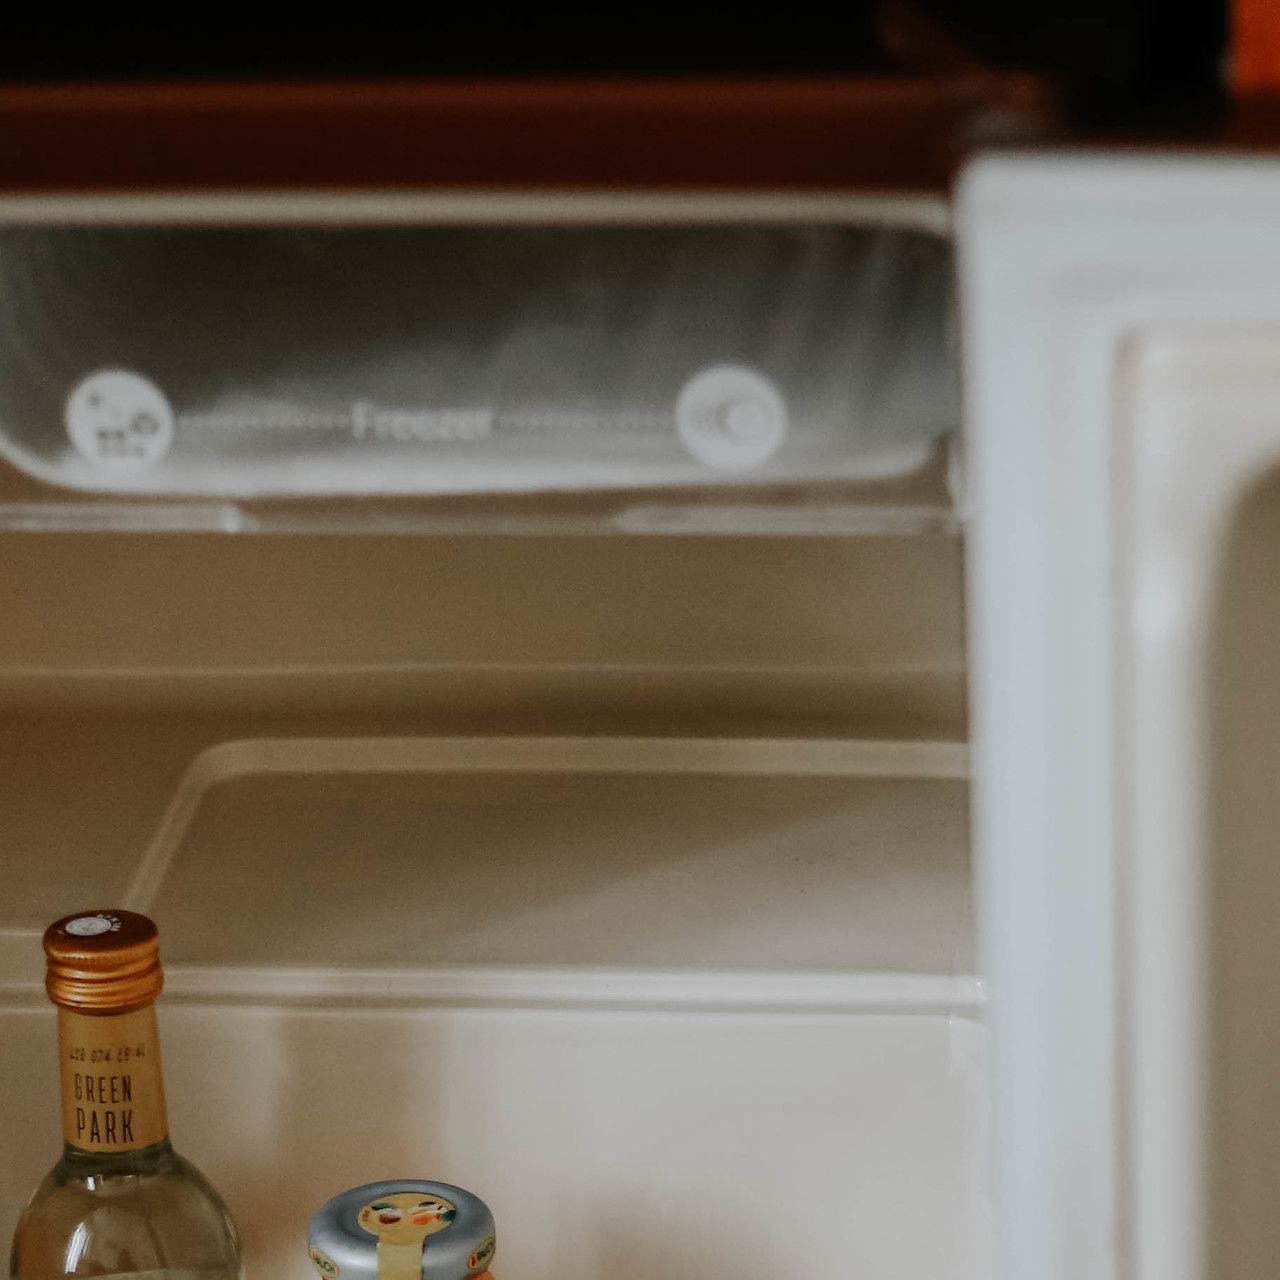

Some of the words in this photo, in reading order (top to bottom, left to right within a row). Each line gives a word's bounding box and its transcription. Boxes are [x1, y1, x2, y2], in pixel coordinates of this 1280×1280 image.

[352, 402, 491, 440] Freezer
[75, 1073, 132, 1104] GREEN
[77, 1107, 134, 1144] PARK
